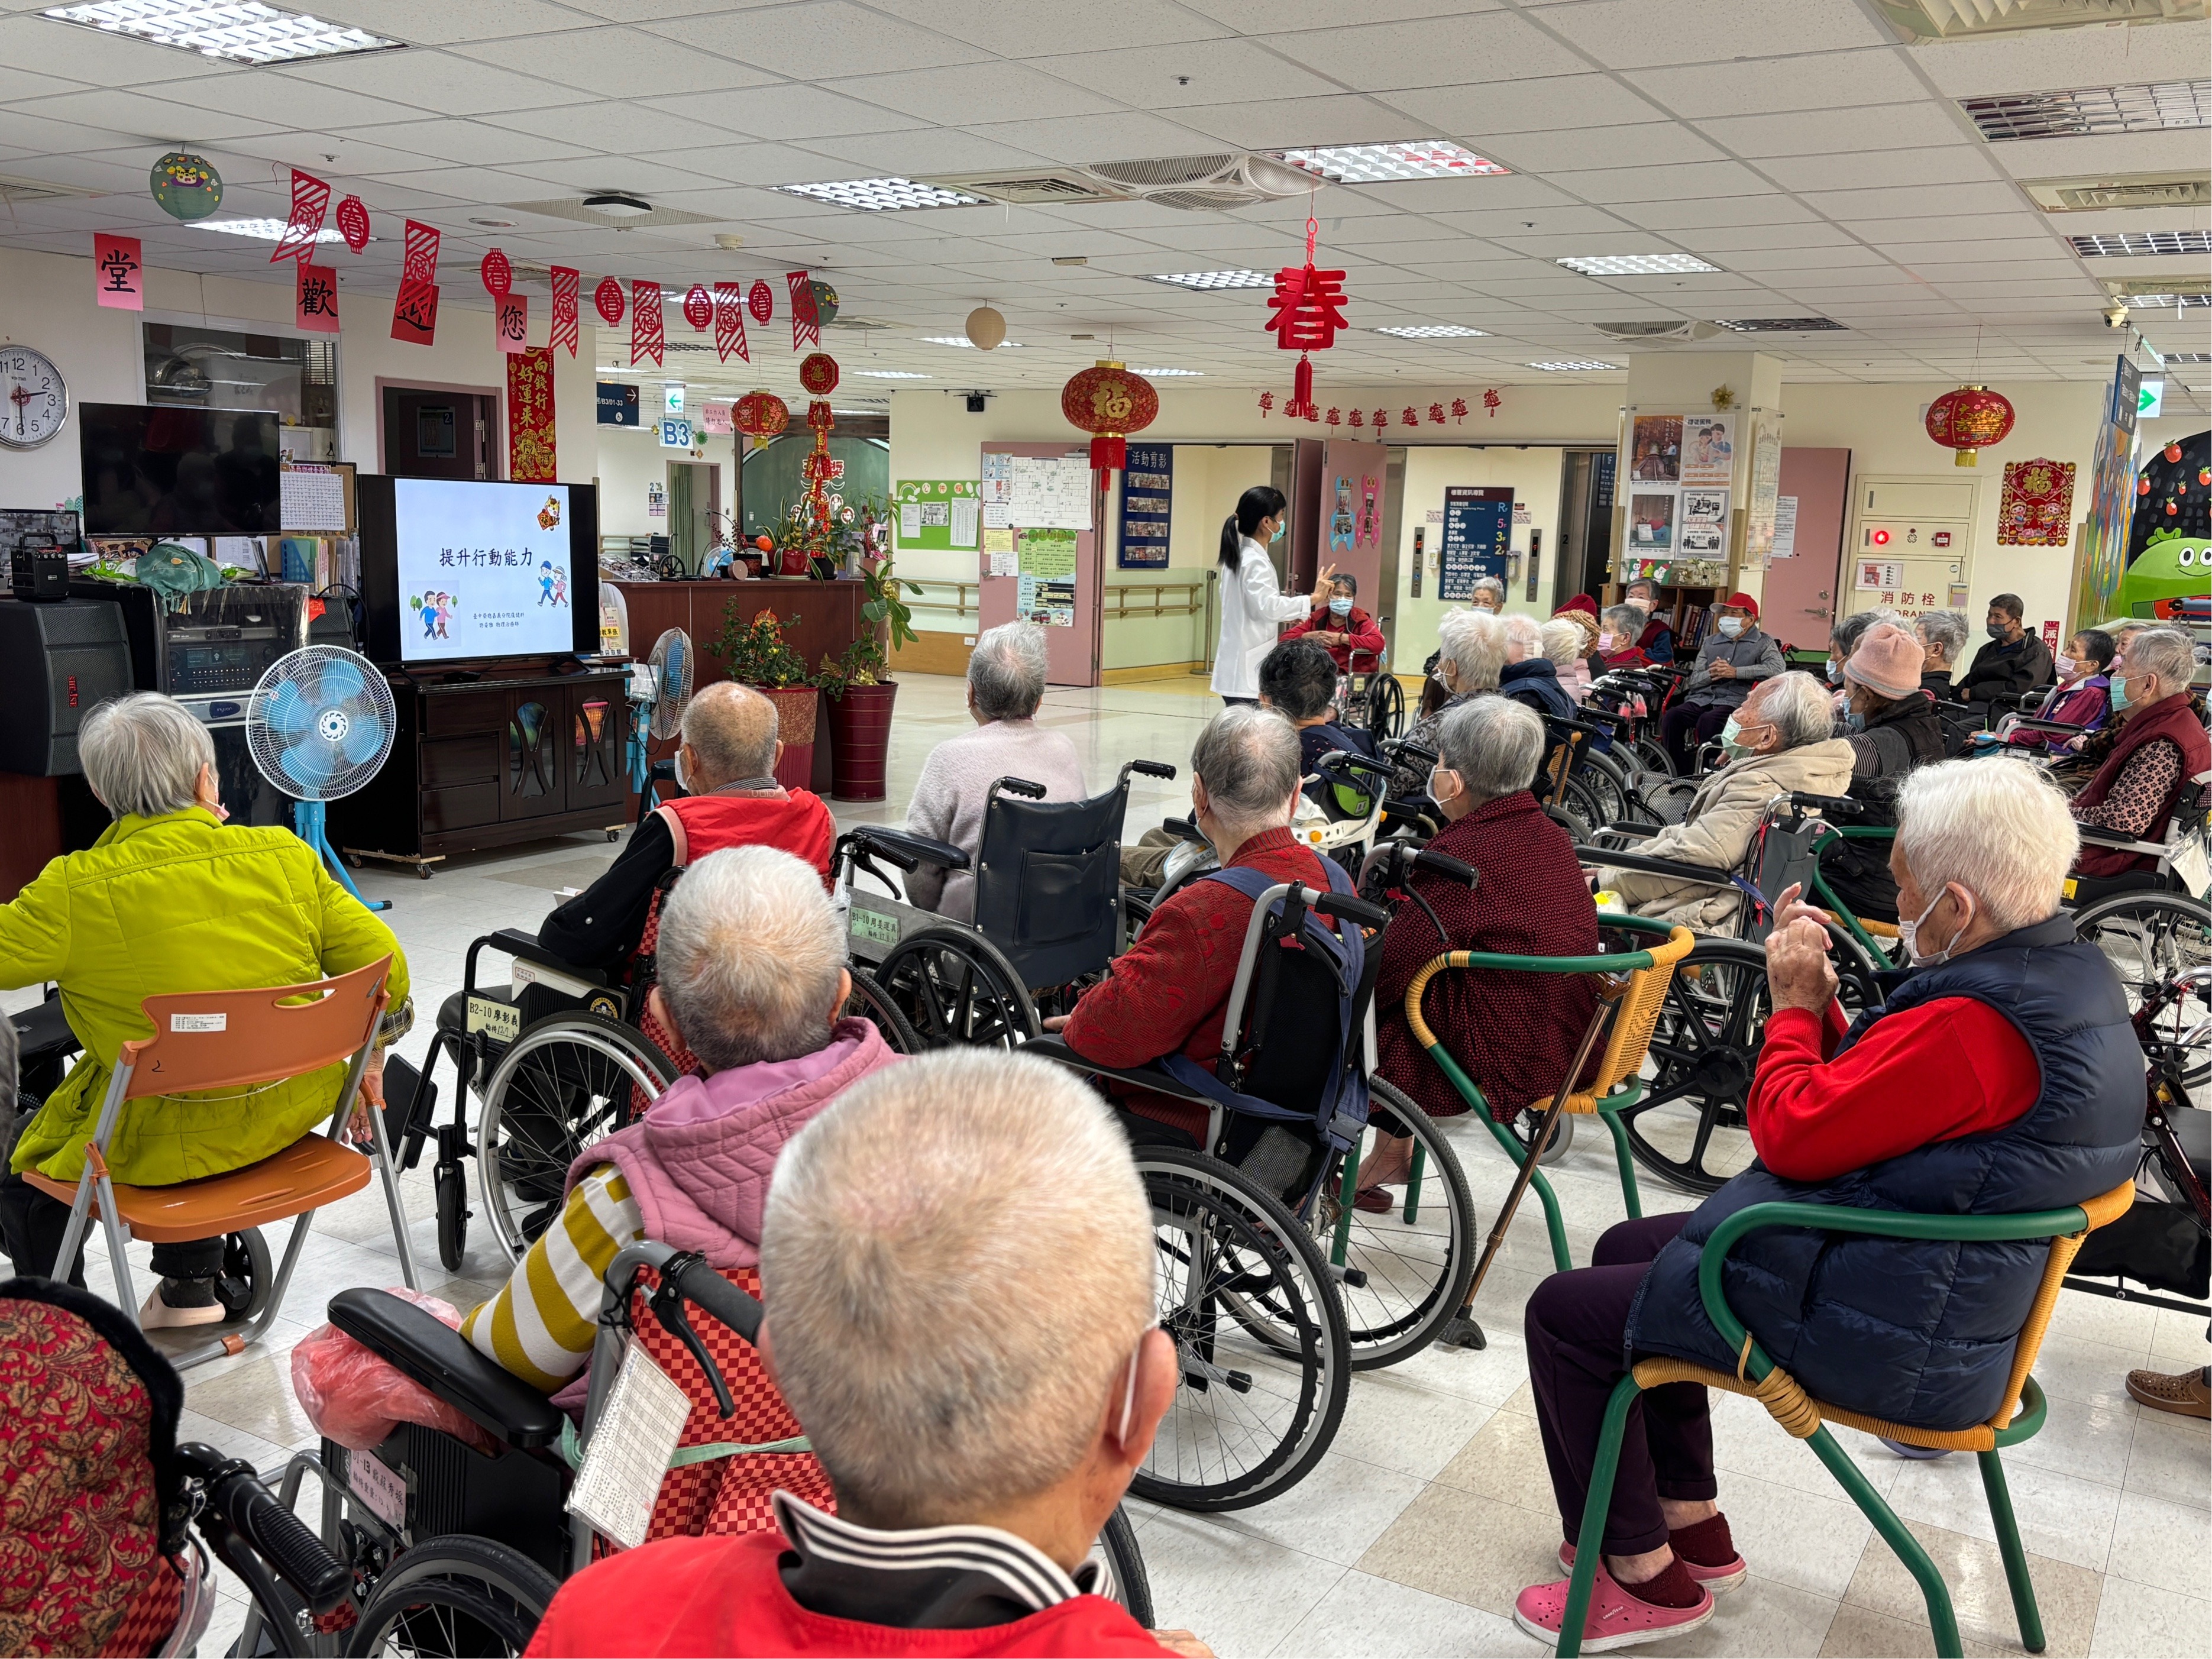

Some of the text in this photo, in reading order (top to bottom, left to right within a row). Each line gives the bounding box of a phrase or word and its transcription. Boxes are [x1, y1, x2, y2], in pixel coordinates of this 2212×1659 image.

[102, 250, 137, 293] 堂
[299, 277, 338, 316] 歡
[499, 305, 525, 341] 您
[1265, 266, 1350, 351] 春
[12, 358, 25, 370] 12
[33, 364, 37, 376] 1
[41, 377, 50, 390] 2
[534, 357, 548, 410] 向錢行
[47, 394, 56, 406] 3
[43, 409, 51, 420] 4
[1, 418, 9, 429] 7
[31, 420, 39, 432] 5
[662, 421, 689, 447] B3
[1131, 451, 1168, 469] 活動剪影
[439, 548, 532, 567] 提升行動能力
[1881, 591, 1935, 606] 消防栓
[852, 912, 869, 924] B1-10
[470, 1002, 492, 1018] B2-10
